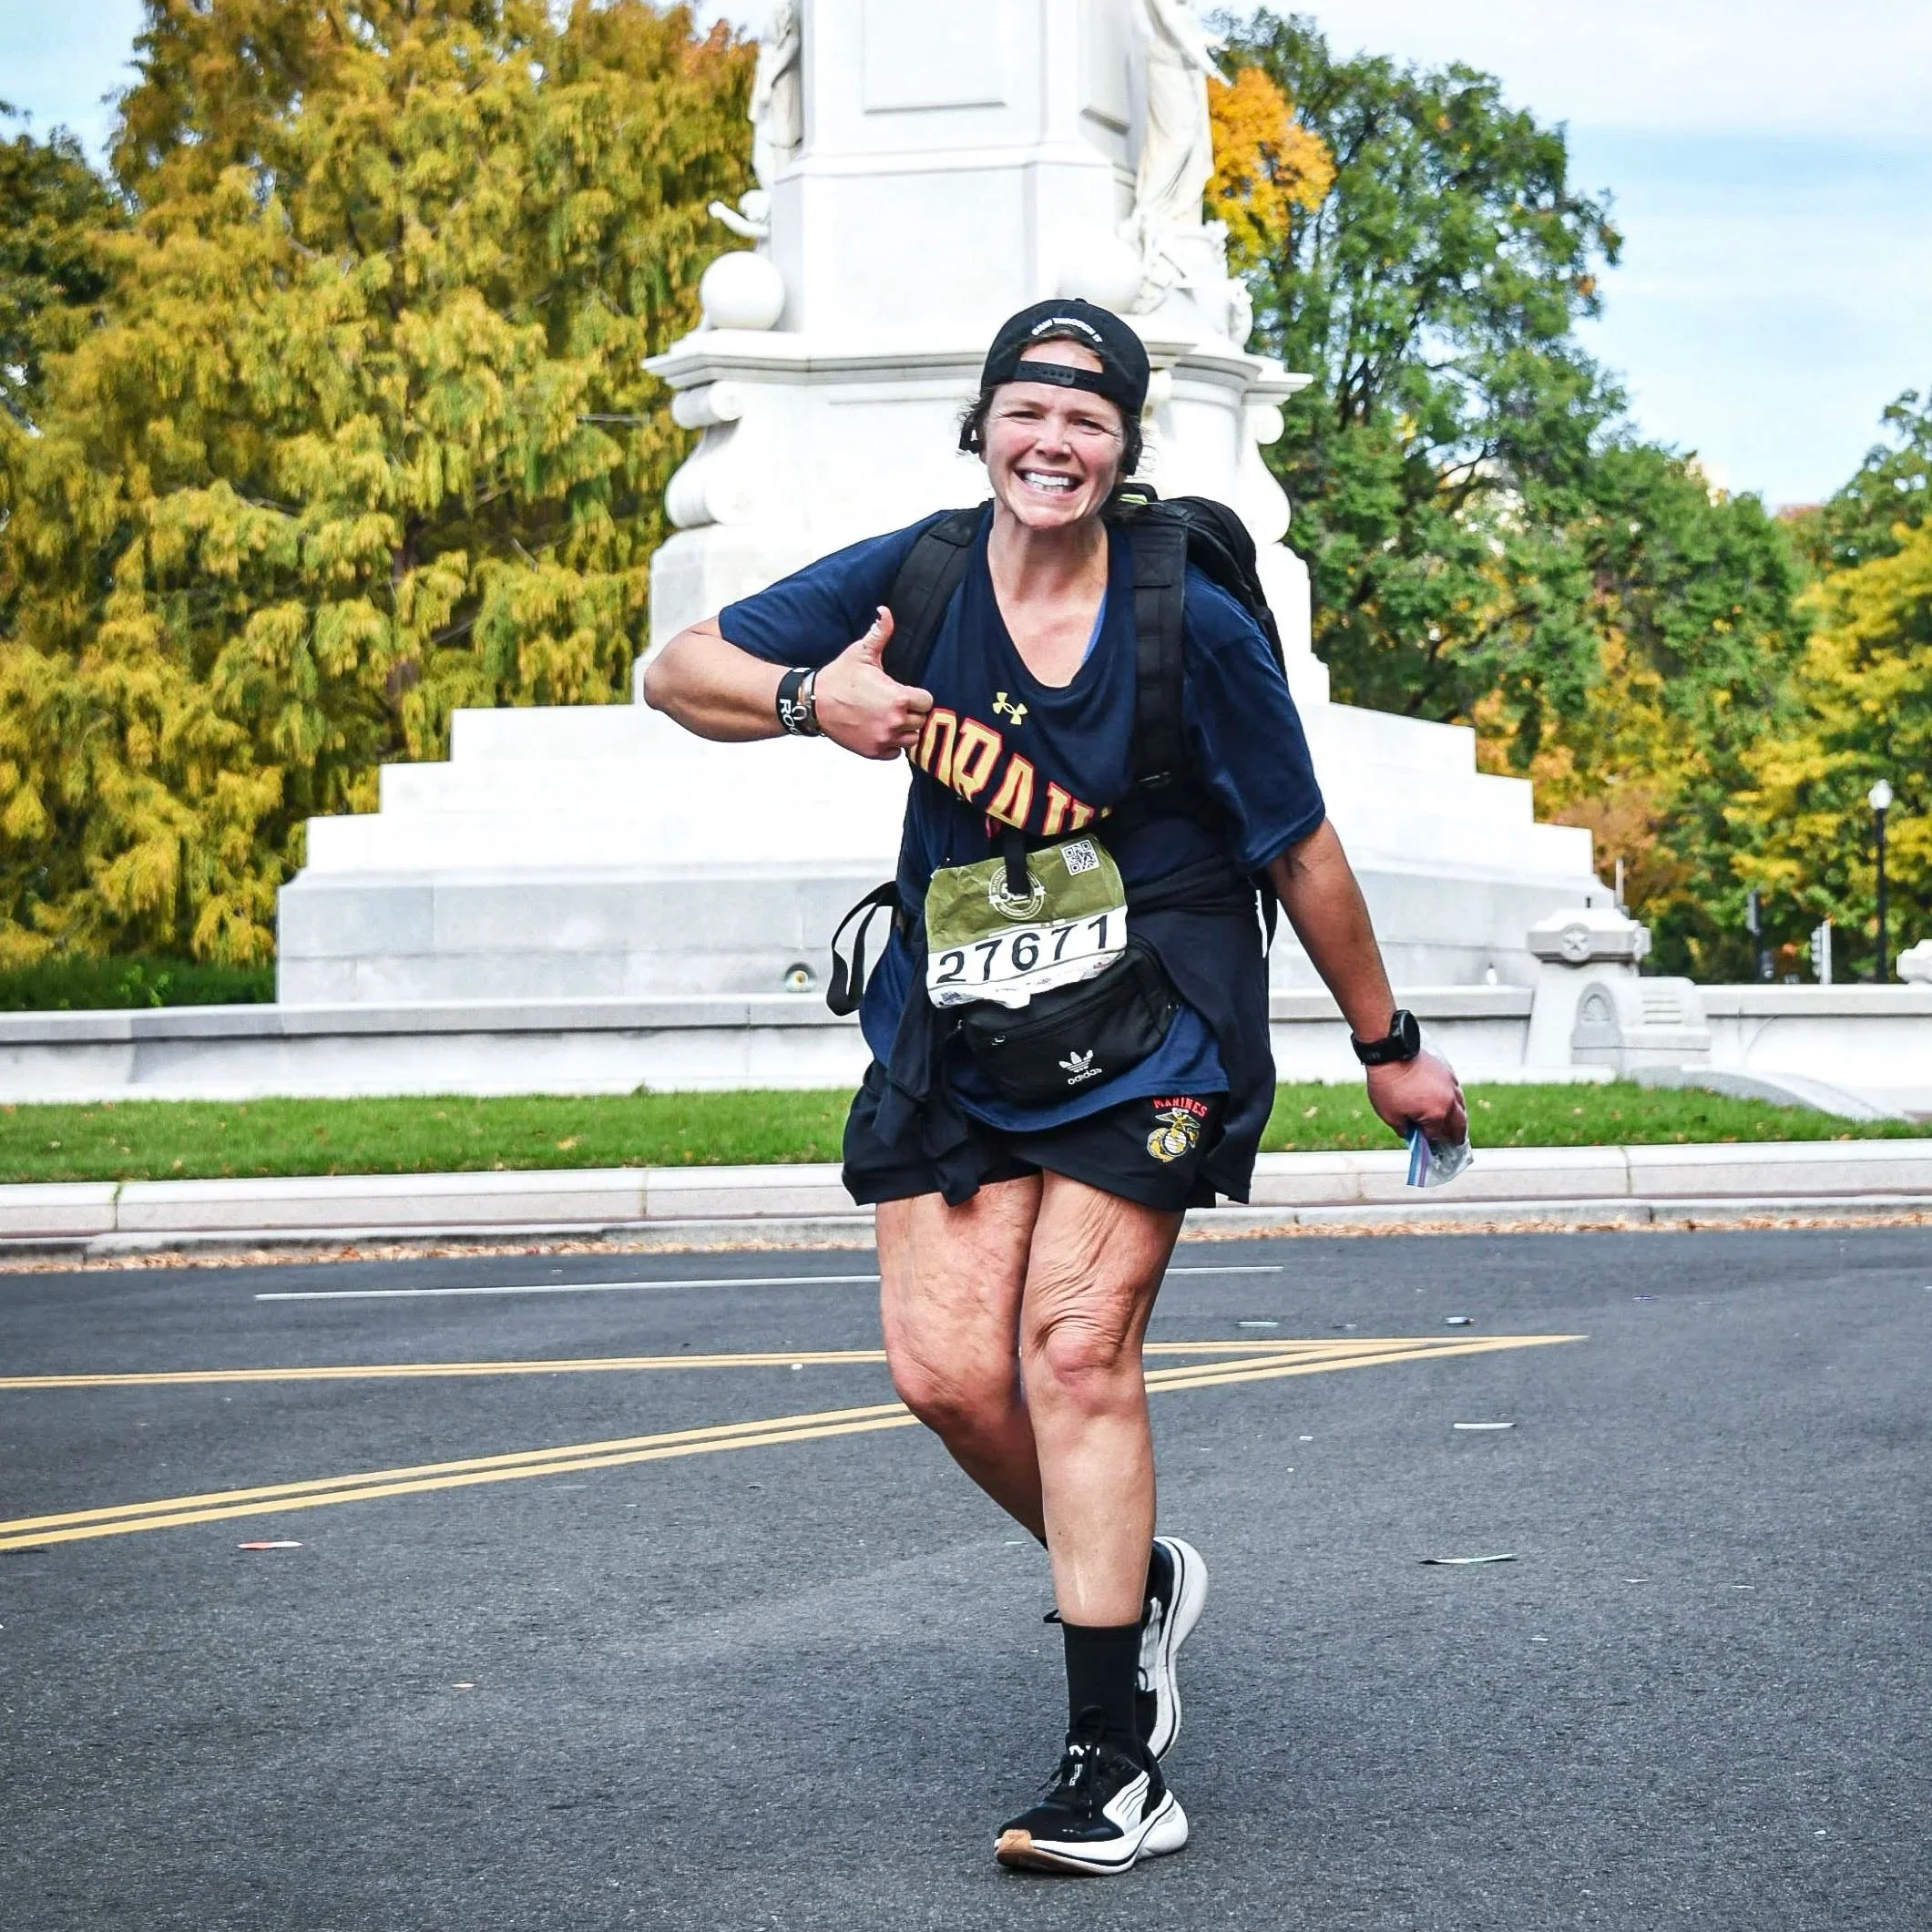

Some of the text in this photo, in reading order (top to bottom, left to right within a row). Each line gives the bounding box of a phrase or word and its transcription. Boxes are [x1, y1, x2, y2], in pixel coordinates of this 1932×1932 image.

[935, 915, 1109, 985] 27671
[1067, 1068, 1103, 1085] adidas
[1152, 1096, 1209, 1118] MARINES
